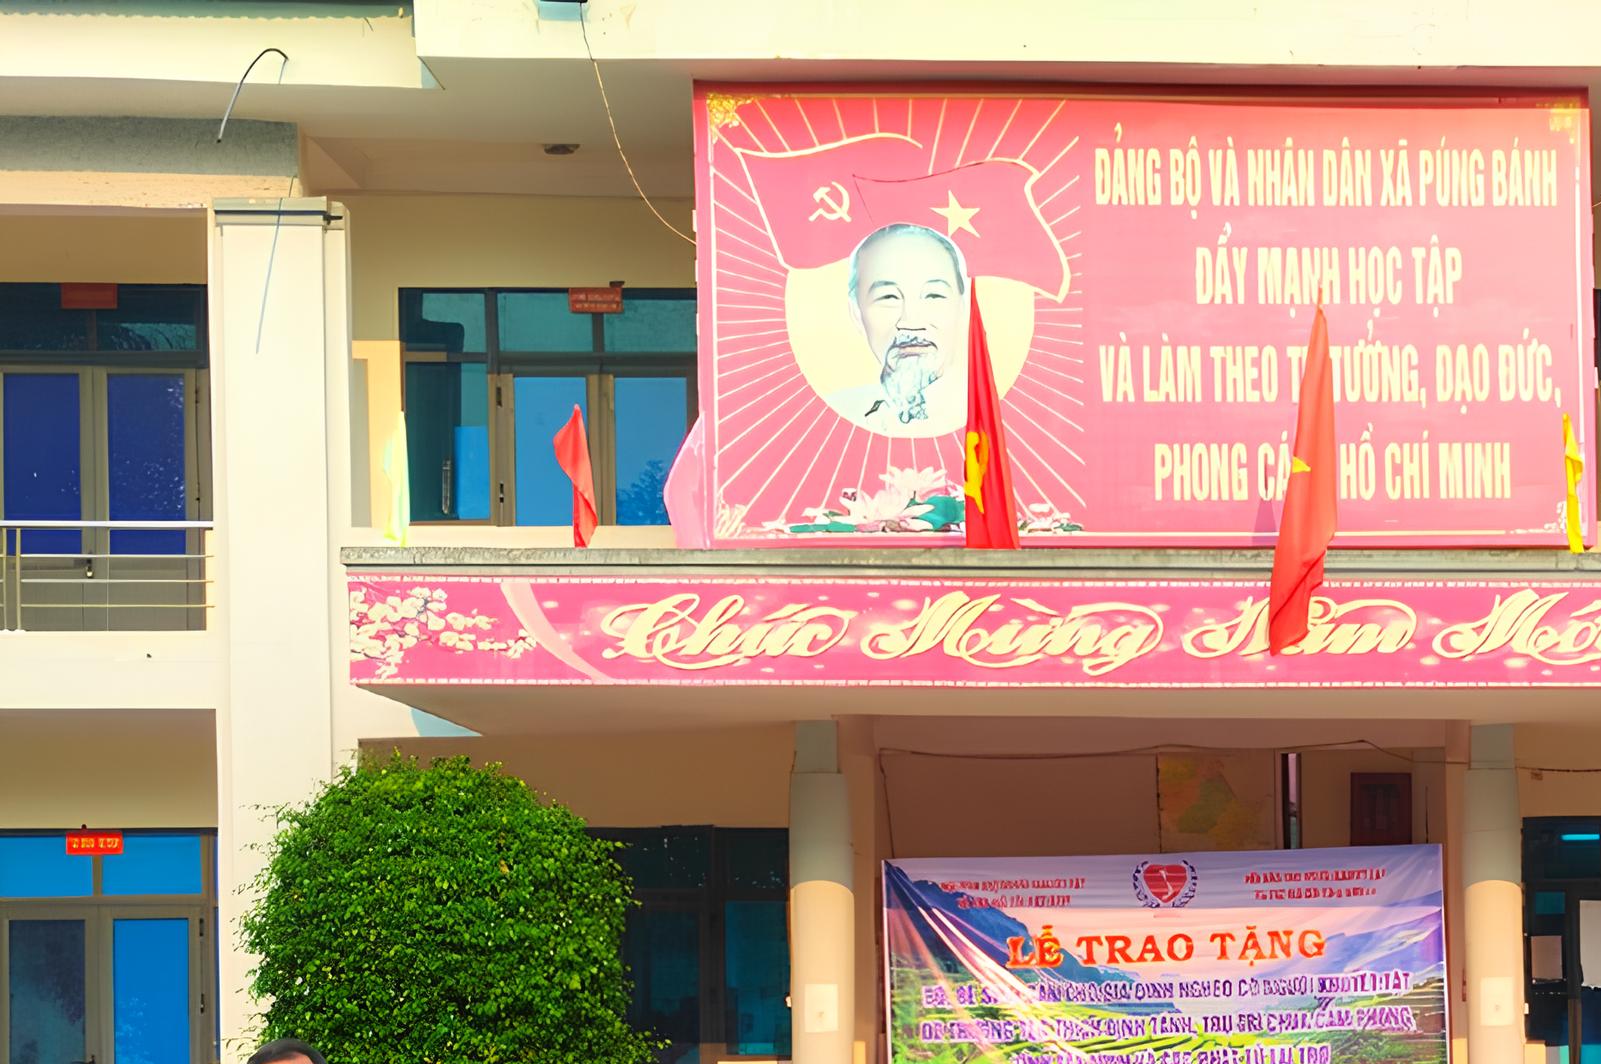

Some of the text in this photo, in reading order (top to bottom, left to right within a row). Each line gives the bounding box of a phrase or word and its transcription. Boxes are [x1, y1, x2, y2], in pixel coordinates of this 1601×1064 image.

[1095, 123, 1558, 219] ĐẢNG BỘ VÀ NHÂN DÂN XÃ PÚNG BÁNH
[1195, 222, 1462, 318] ĐẨY MẠNH HỌC TẬP
[1099, 319, 1562, 414] VÀ LÀM THEO T TƯỞNG, ĐẠO ĐỨC,
[1154, 422, 1511, 501] PHONG CÁ HỒ CHÍ MINH
[600, 594, 858, 671] Chúc
[860, 590, 1164, 677] Mừng
[1006, 925, 1326, 968] LỄ TRAO TẶNG
